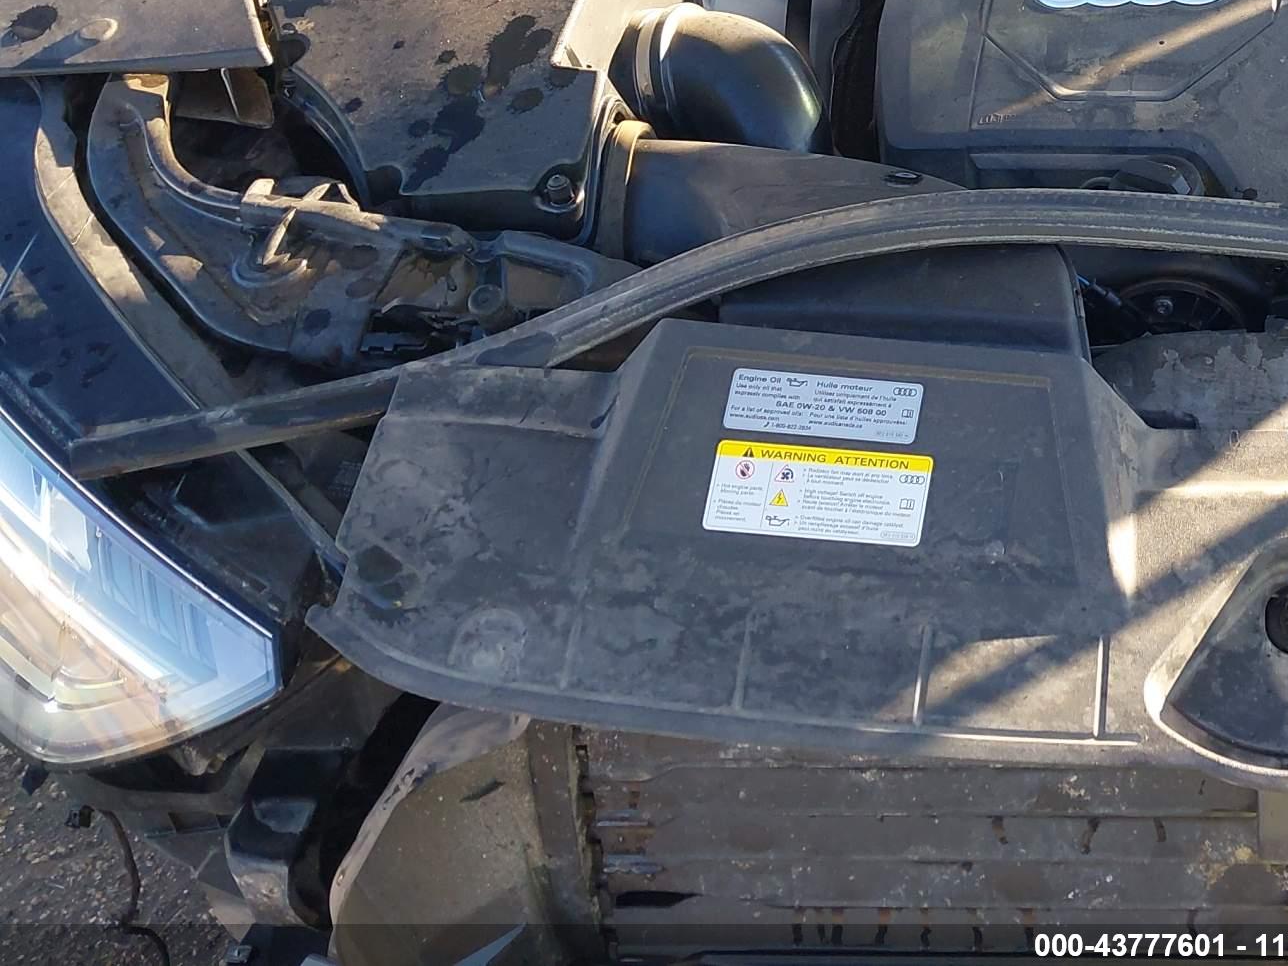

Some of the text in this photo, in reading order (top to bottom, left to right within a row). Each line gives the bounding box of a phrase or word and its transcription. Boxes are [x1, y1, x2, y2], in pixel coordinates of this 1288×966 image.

[738, 374, 767, 383] Engine
[840, 383, 872, 391] moteur
[796, 402, 825, 410] 0W-20
[760, 449, 909, 469] WARNING ATTENTION
